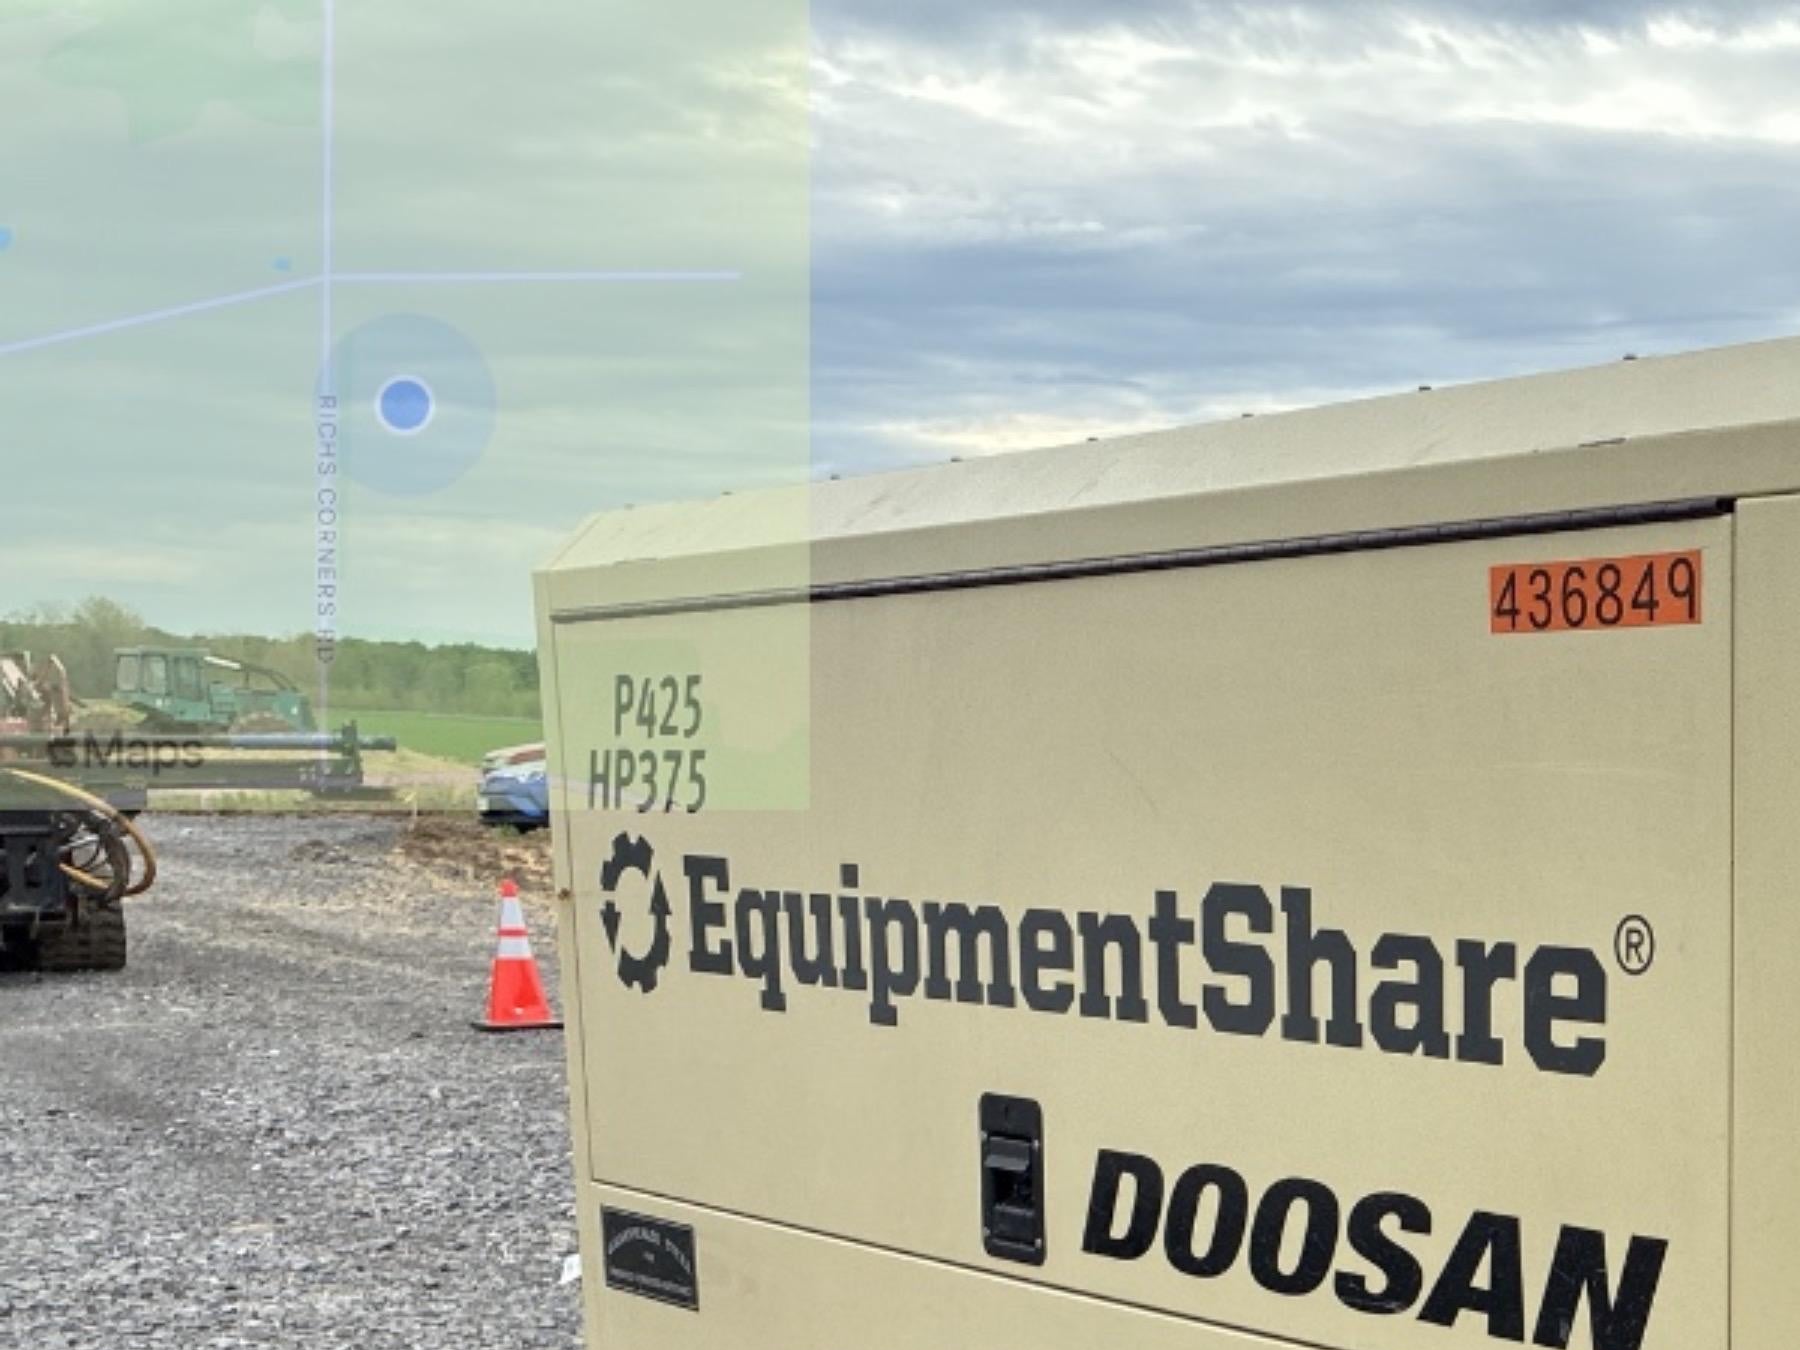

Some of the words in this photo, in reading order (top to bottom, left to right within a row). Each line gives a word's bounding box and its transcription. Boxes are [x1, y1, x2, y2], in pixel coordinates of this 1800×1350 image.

[1494, 556, 1697, 630] 436849
[613, 674, 703, 740] P425
[588, 748, 708, 815] HP375
